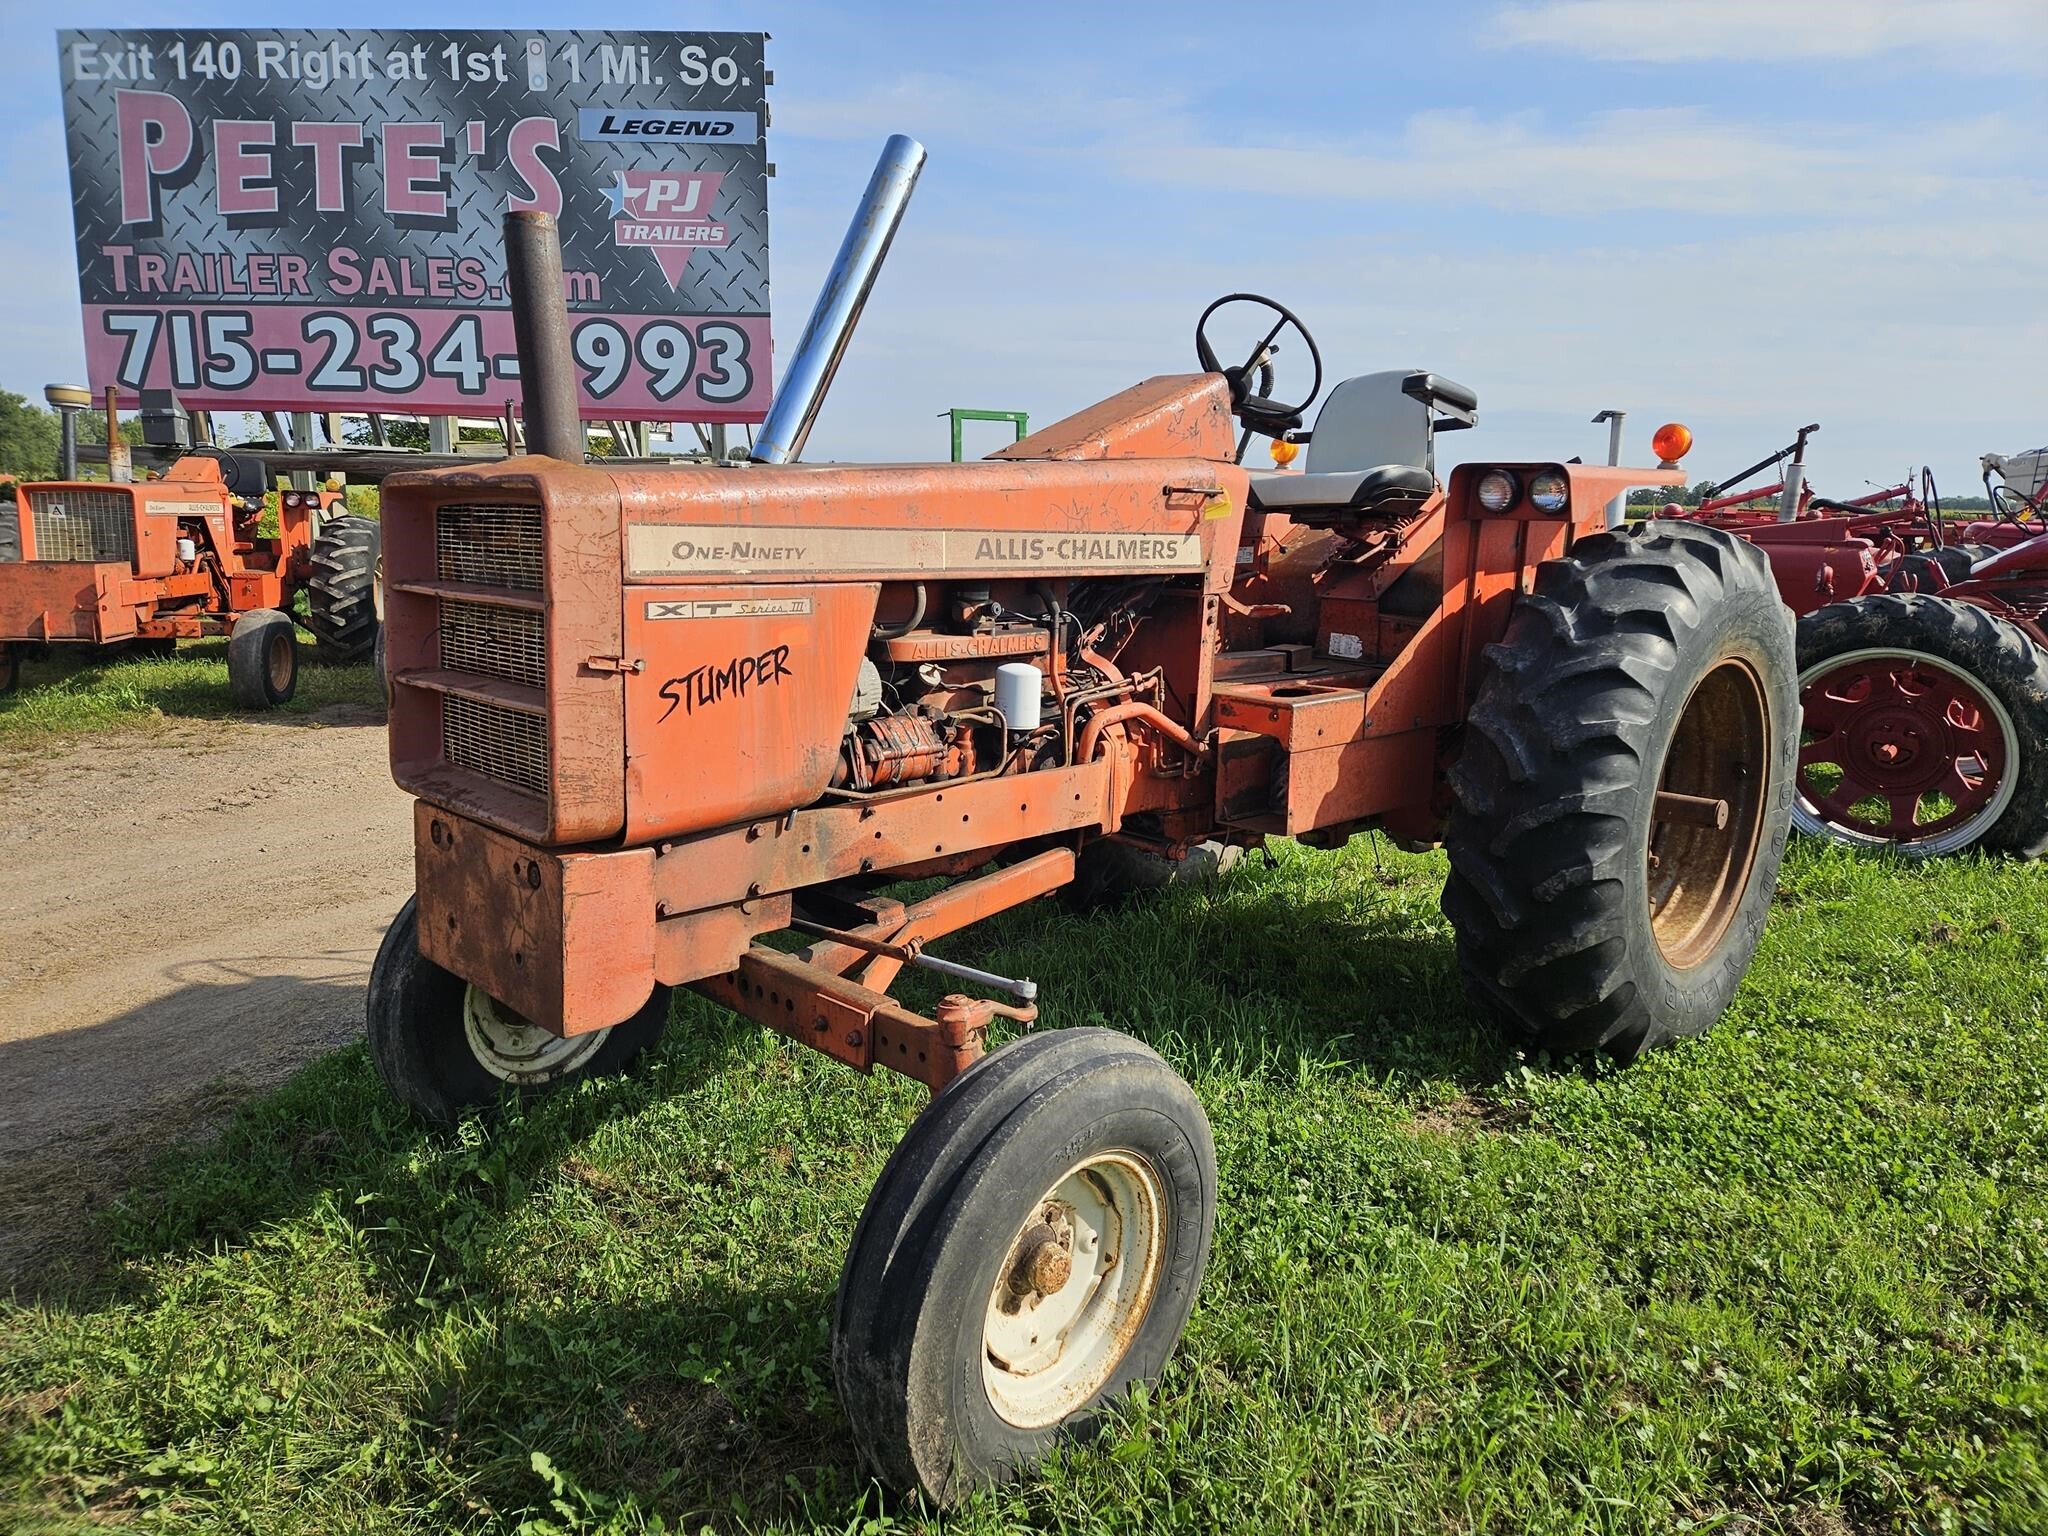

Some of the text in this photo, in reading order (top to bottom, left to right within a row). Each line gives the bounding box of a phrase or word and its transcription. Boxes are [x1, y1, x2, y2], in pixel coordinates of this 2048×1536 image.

[72, 40, 750, 90] Exit 140 Right at 1st 1 Mi. So.
[598, 115, 735, 137] LEGEND
[114, 86, 563, 225] PETE'S
[644, 179, 703, 213] PJ
[622, 224, 725, 242] TRAILERS
[102, 245, 601, 302] TRAILER SALES.m
[102, 308, 754, 403] 715-234-993
[671, 540, 807, 561] ONE-NINETY
[974, 537, 1179, 561] ALLIS-CHALMERS
[735, 603, 788, 615] Series
[911, 634, 1043, 660] ALLIS-CHALMERS
[656, 644, 793, 725] STUMPER
